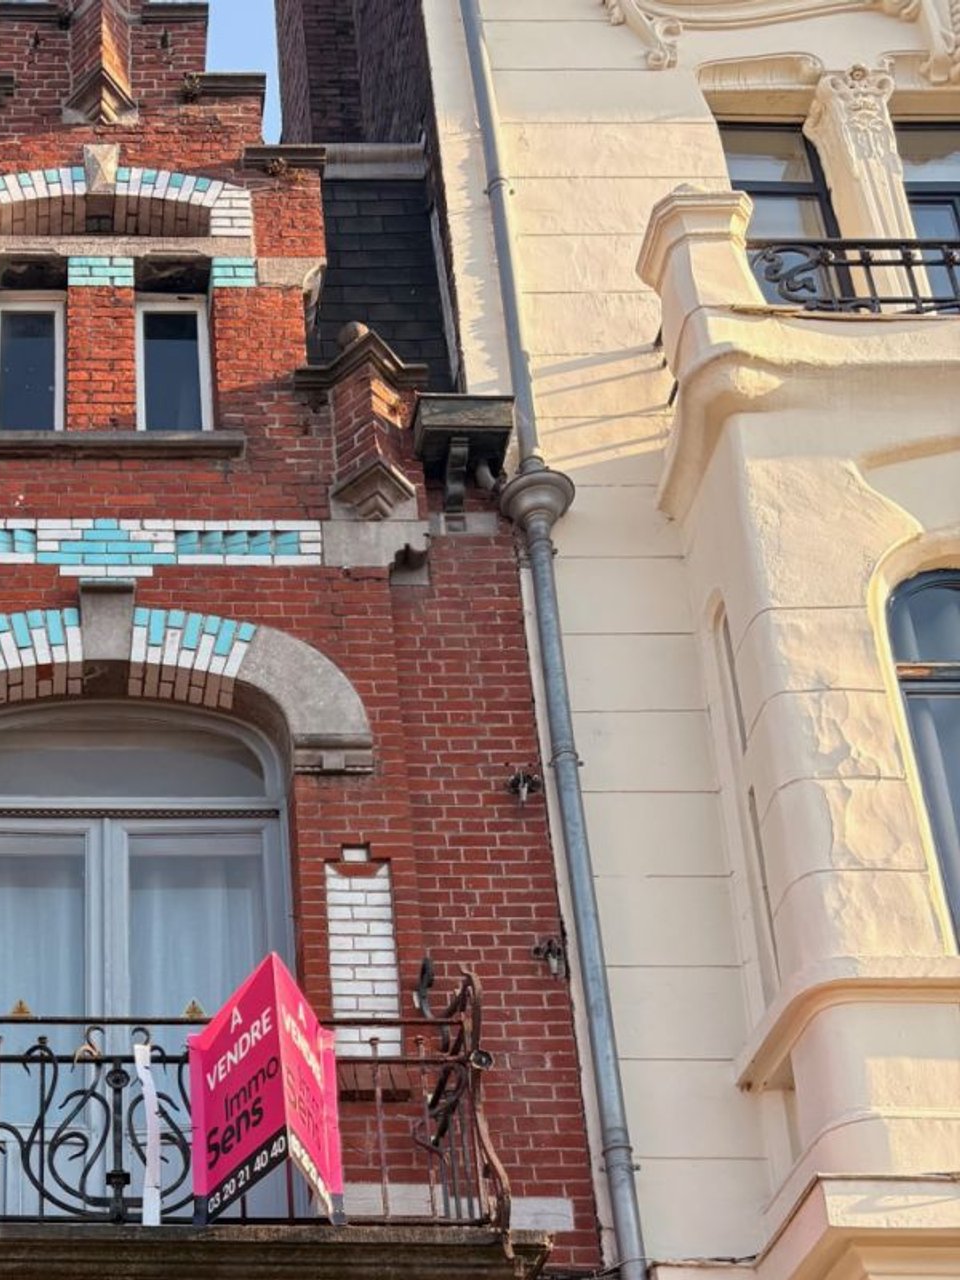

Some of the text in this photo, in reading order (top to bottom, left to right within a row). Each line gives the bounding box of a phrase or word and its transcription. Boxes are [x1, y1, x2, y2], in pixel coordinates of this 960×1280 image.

[205, 1006, 273, 1092] VENDRE
[223, 1055, 280, 1121] Immo
[206, 1096, 264, 1171] Sens
[207, 1135, 287, 1214] 03 20 21 40 40
